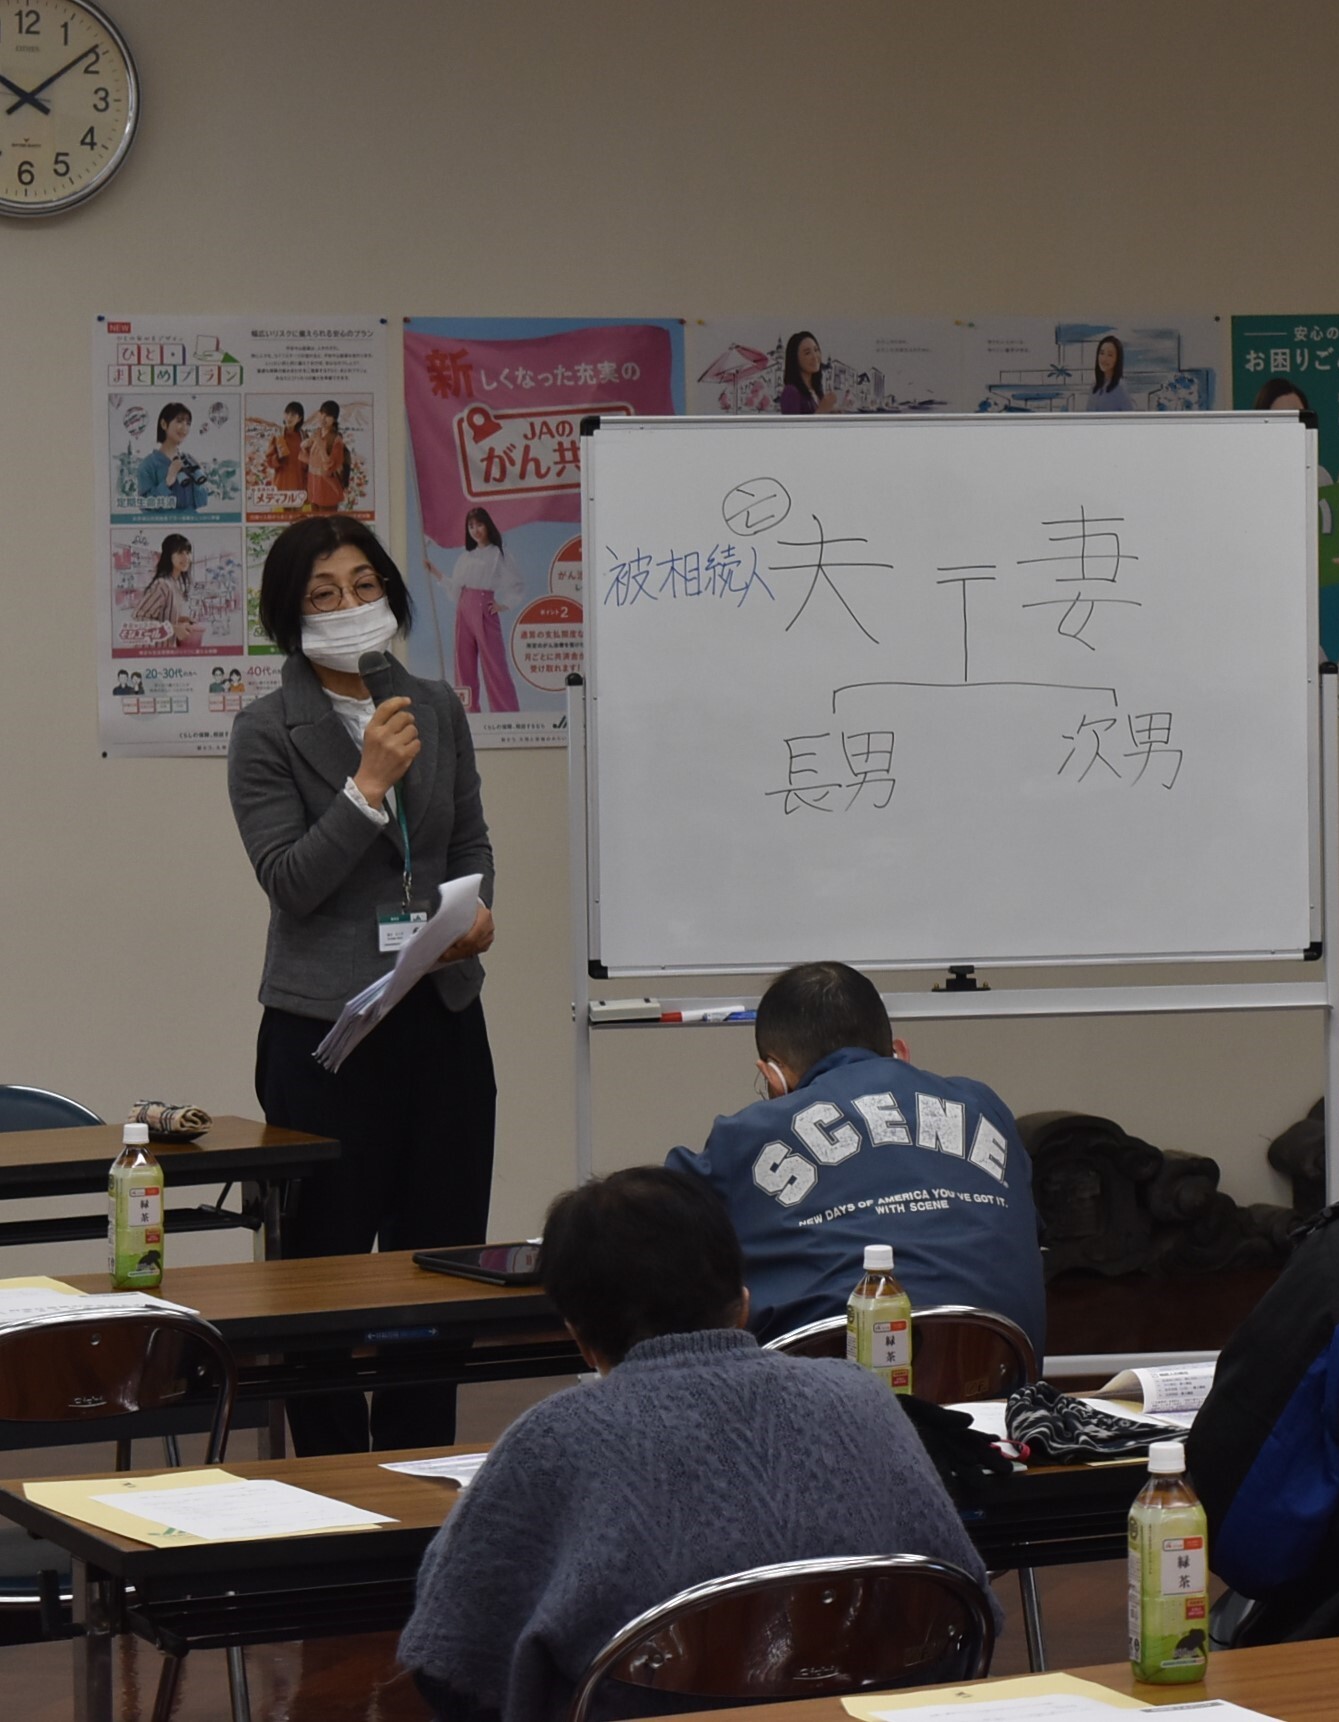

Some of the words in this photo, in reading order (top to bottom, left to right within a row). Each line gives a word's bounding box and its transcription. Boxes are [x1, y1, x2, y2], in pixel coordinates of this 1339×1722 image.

[15, 9, 40, 35] 12
[60, 21, 69, 46] 1
[83, 50, 100, 74] 2
[93, 87, 109, 112] 3
[80, 126, 97, 150] 4
[17, 160, 35, 185] 6
[53, 152, 70, 177] 5
[109, 324, 129, 332] NEW
[425, 348, 641, 400] 新しくなった充実の
[523, 420, 574, 441] JAの
[604, 543, 776, 608] 被相続人
[769, 514, 894, 645] 夫
[1016, 505, 1143, 651] 妻
[1057, 712, 1184, 790] 次男
[765, 731, 897, 815] 長男
[752, 1091, 1008, 1208] SCENE
[799, 1213, 823, 1226] NEW
[826, 1203, 856, 1222] DAYS
[857, 1199, 874, 1209] OF
[877, 1188, 930, 1206] AMERICA
[973, 1193, 995, 1205] GOT
[875, 1202, 905, 1216] WITH
[909, 1200, 950, 1213] SCENE
